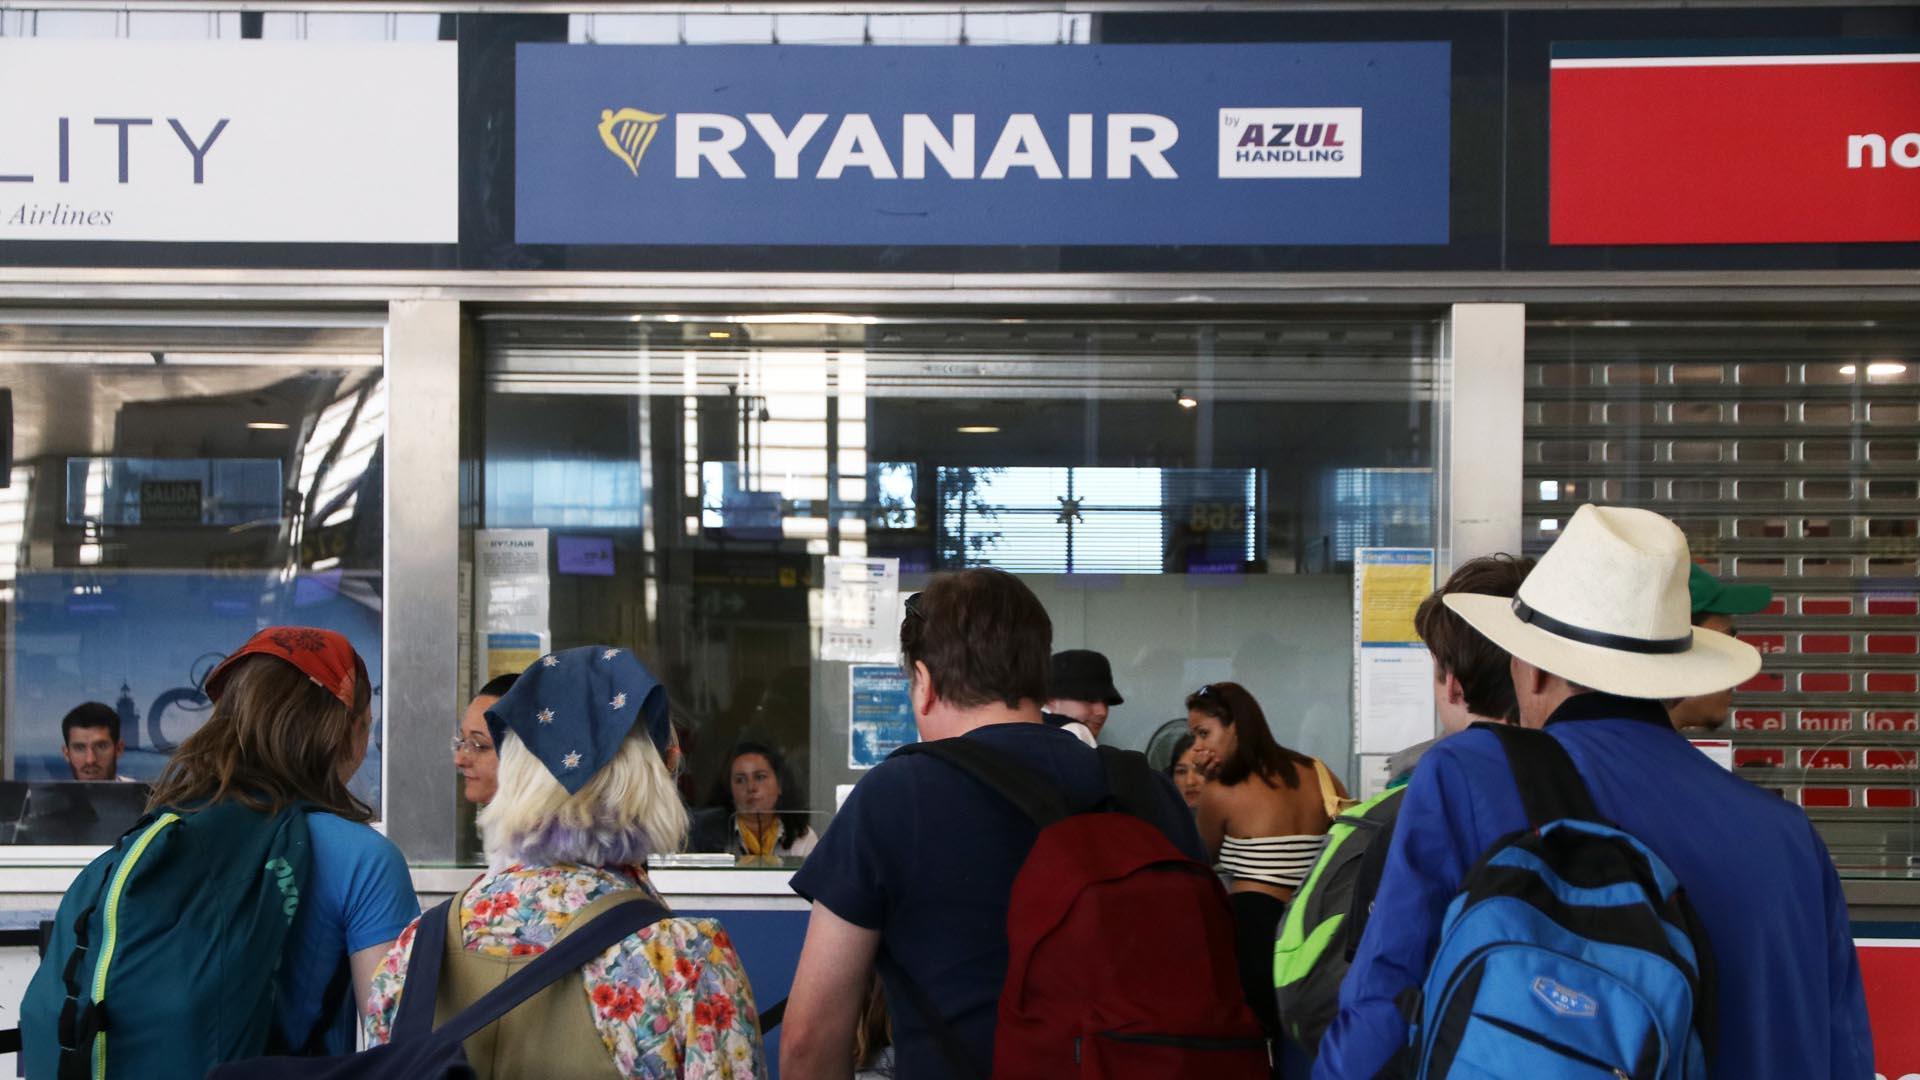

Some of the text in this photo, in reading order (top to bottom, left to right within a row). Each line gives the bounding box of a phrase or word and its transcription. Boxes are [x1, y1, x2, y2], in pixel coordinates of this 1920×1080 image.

[1224, 115, 1240, 127] by
[675, 113, 1179, 179] RYANAIR
[1237, 123, 1345, 147] AZUL
[1236, 150, 1344, 162] HANDLING
[1847, 133, 1920, 168] no
[8, 203, 113, 226] Airlines
